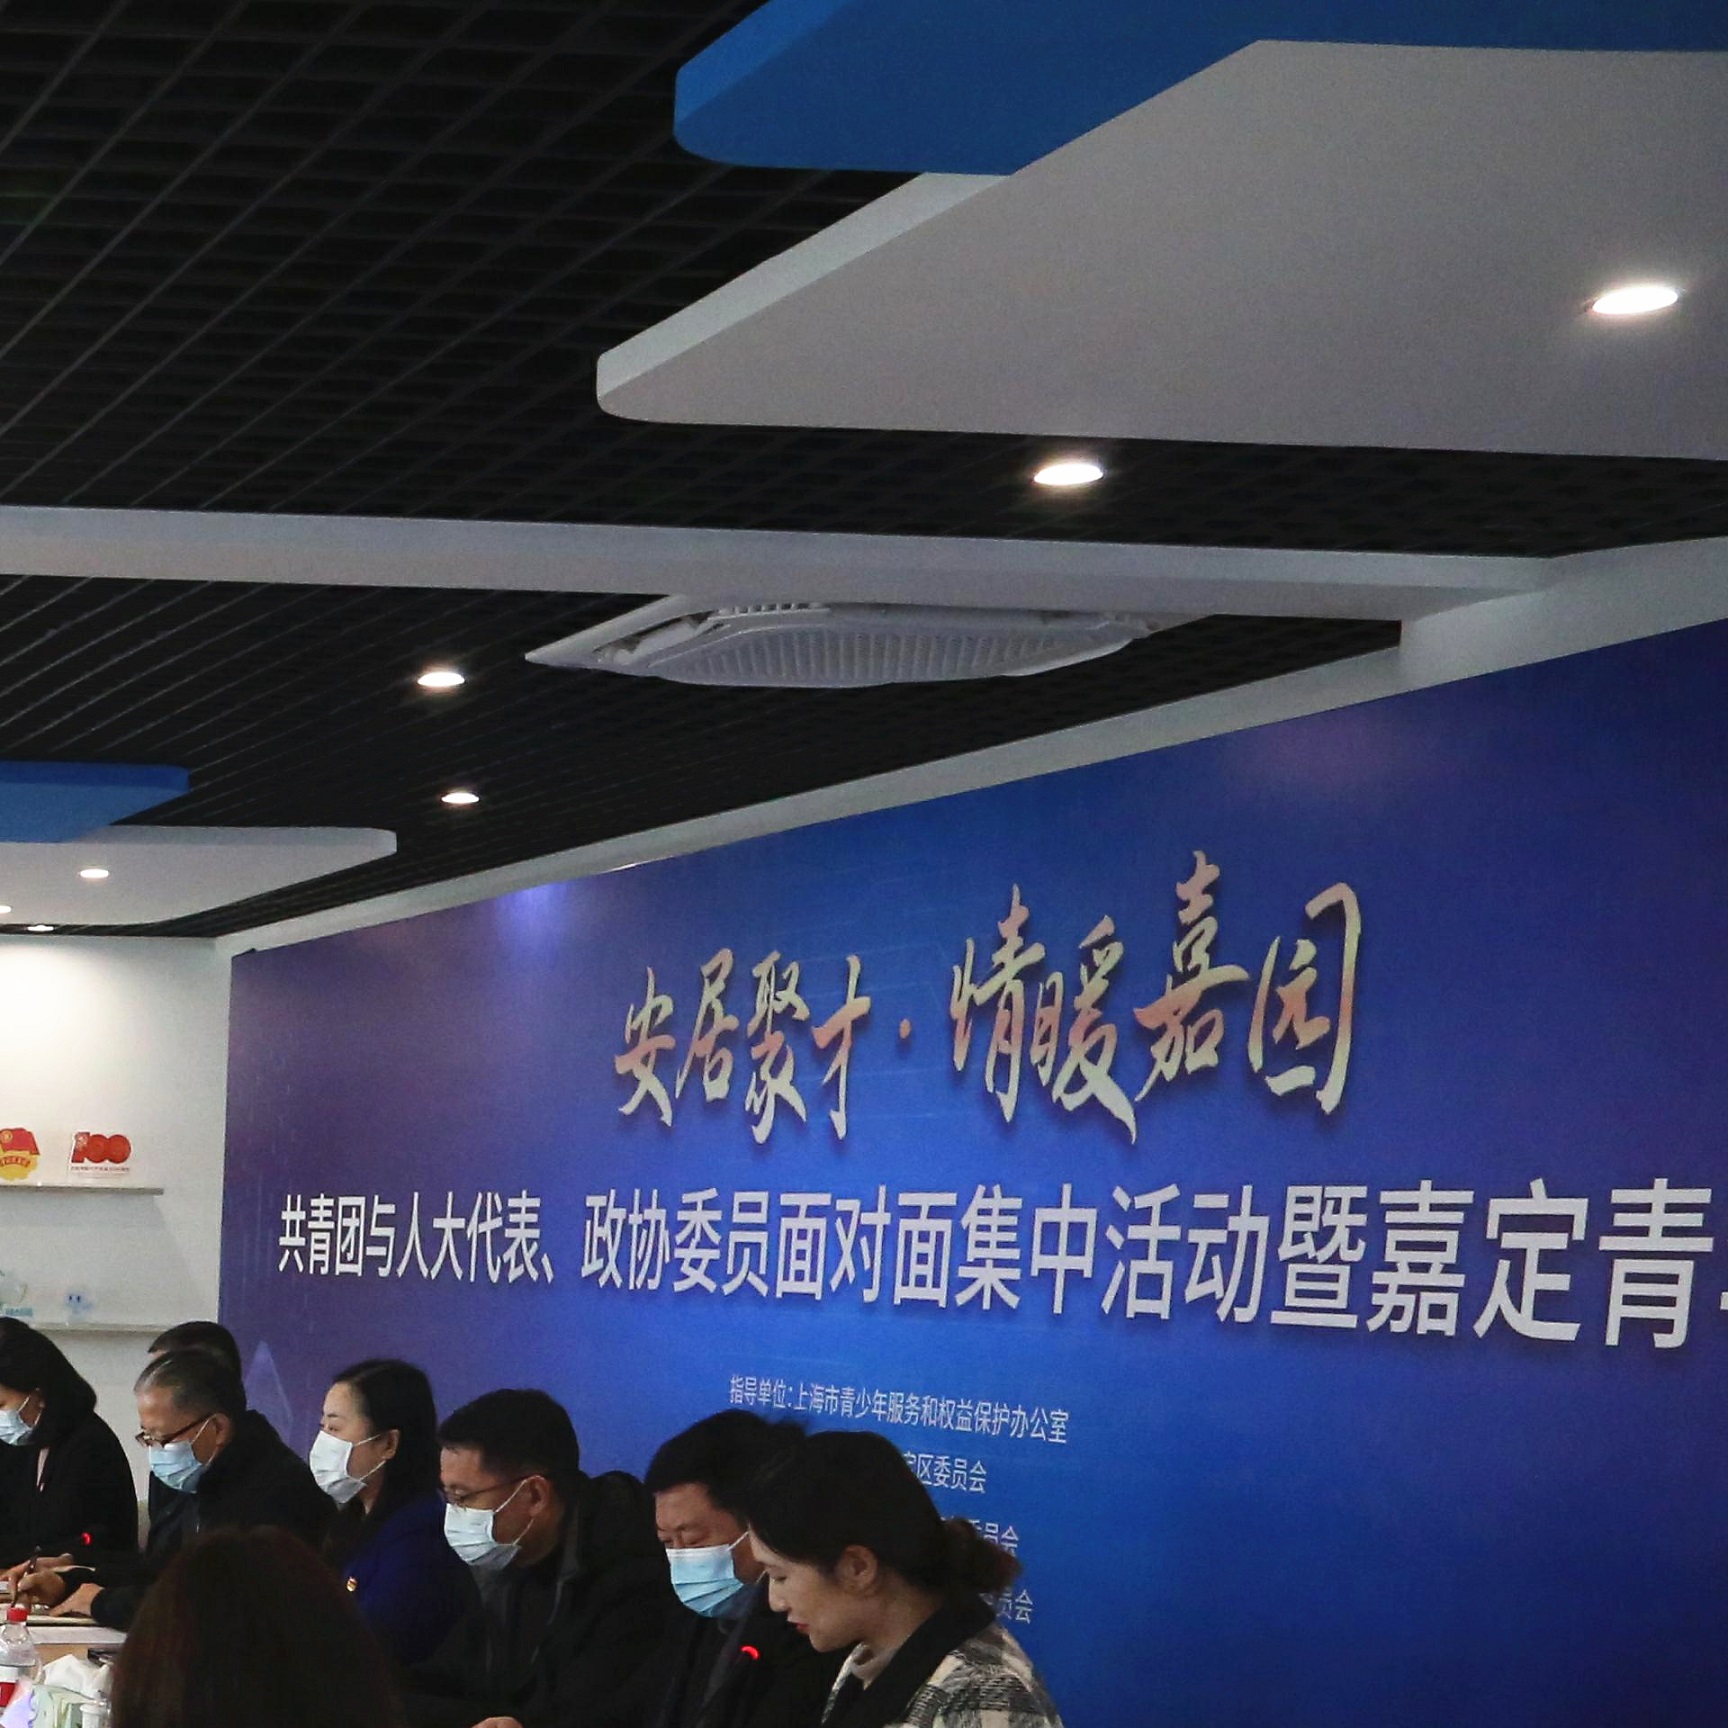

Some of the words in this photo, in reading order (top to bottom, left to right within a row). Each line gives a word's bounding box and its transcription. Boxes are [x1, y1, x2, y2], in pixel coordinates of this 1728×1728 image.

[613, 849, 1363, 1146] 安居聚才·情暖嘉园
[278, 1174, 1728, 1349] 共青团与人大代表、政协委员面对面集中活动暨嘉定青
